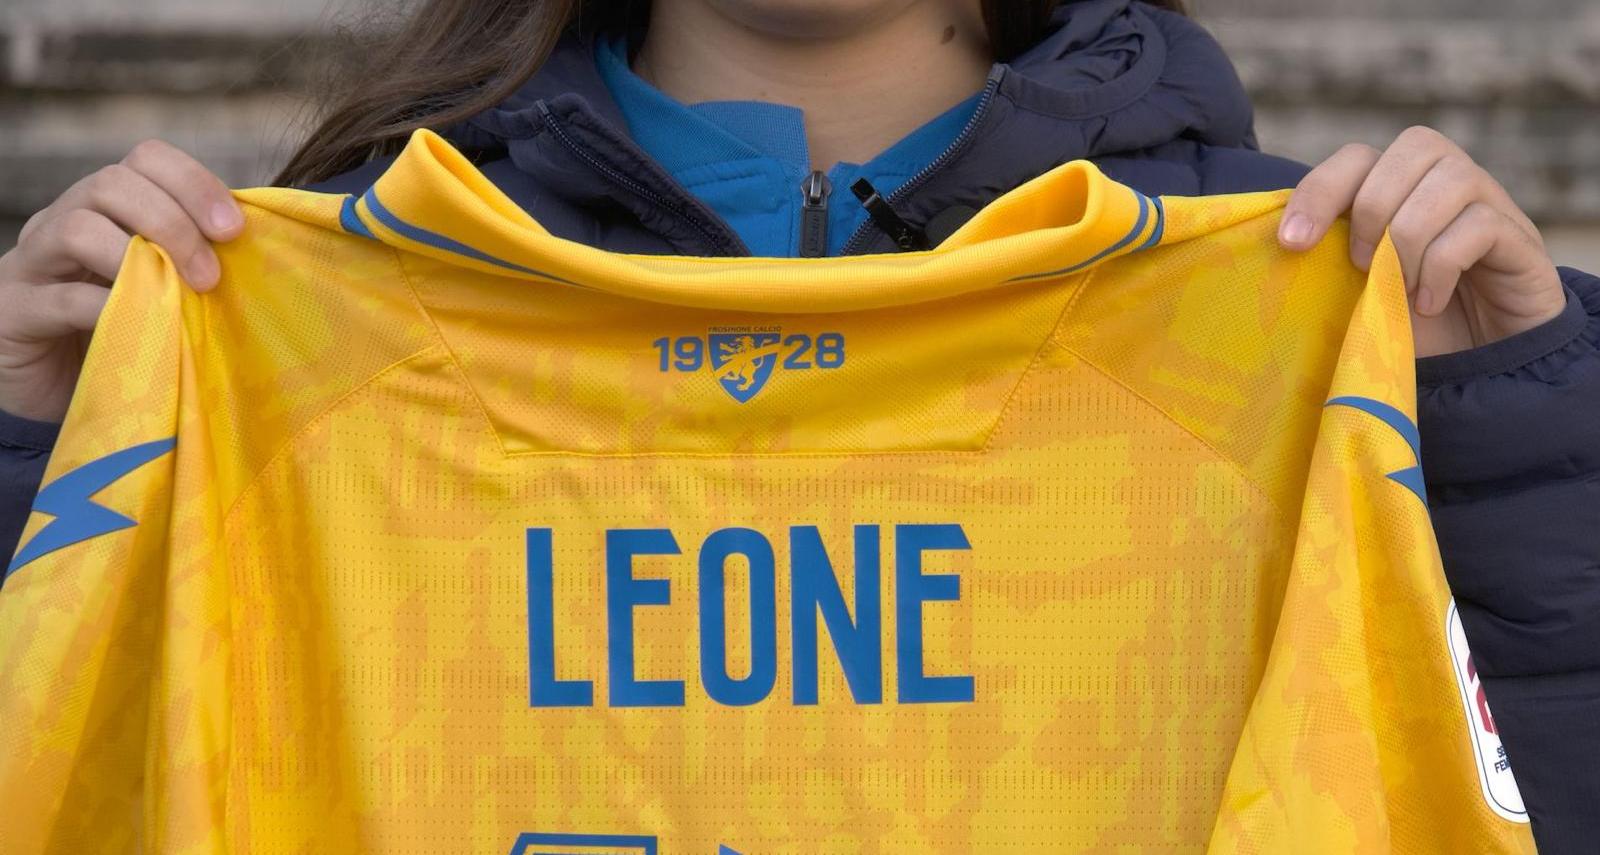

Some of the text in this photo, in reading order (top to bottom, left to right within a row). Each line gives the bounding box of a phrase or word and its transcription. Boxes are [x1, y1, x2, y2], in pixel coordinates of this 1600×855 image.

[653, 332, 845, 372] 19 28
[526, 523, 975, 707] LEONE
